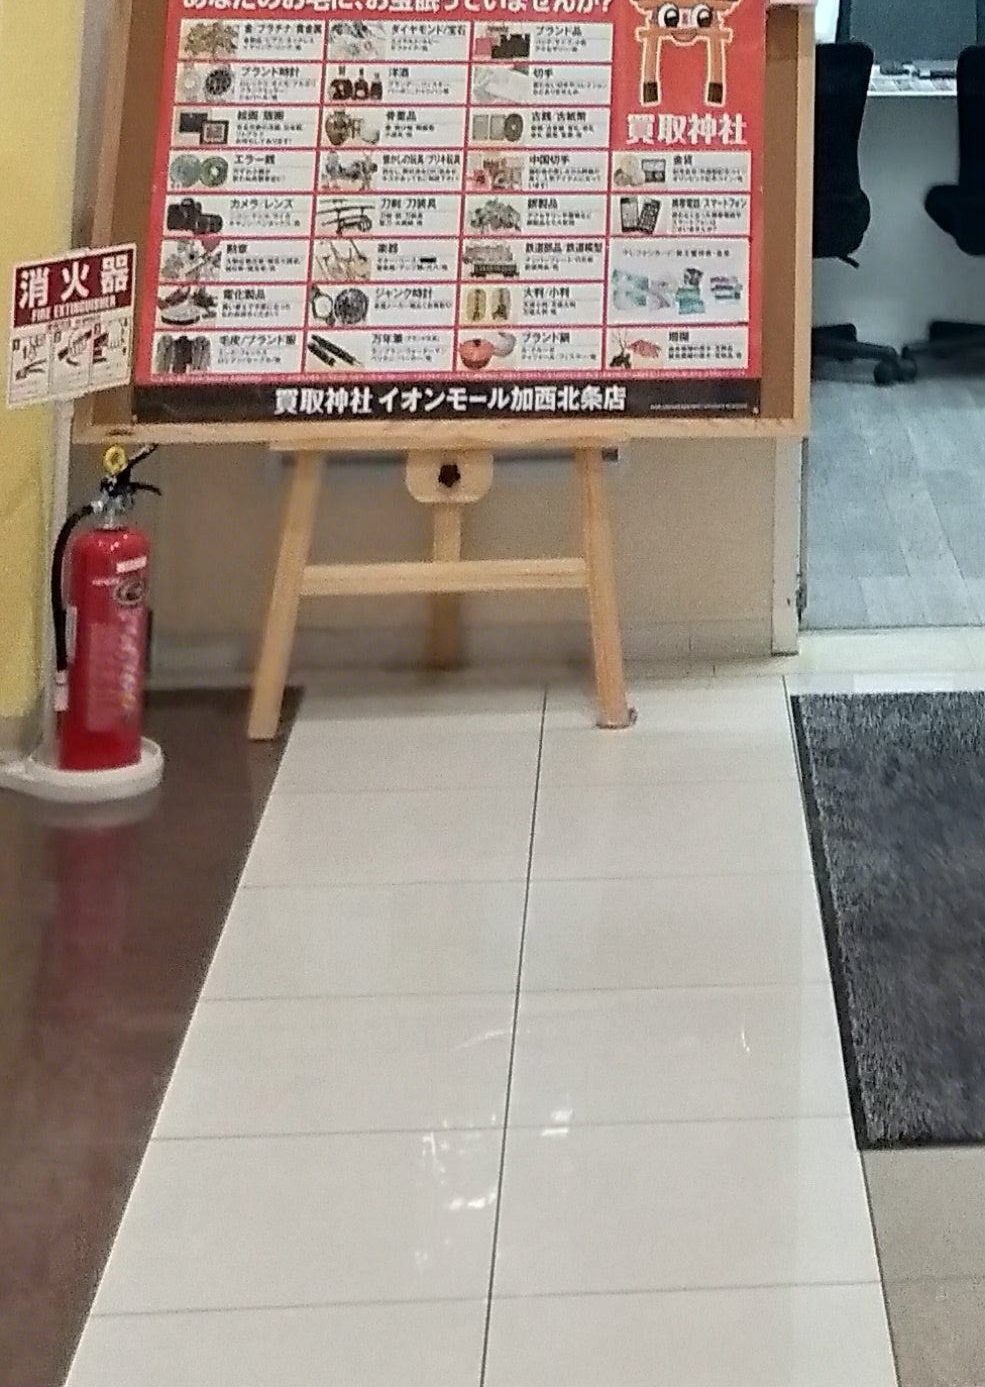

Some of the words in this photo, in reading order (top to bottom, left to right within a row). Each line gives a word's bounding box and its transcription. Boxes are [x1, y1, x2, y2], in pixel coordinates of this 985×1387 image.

[625, 113, 747, 145] 買取神社
[19, 253, 130, 309] 消火器
[274, 386, 373, 415] 買取神社
[379, 384, 627, 413] イオンモール加西北条店
